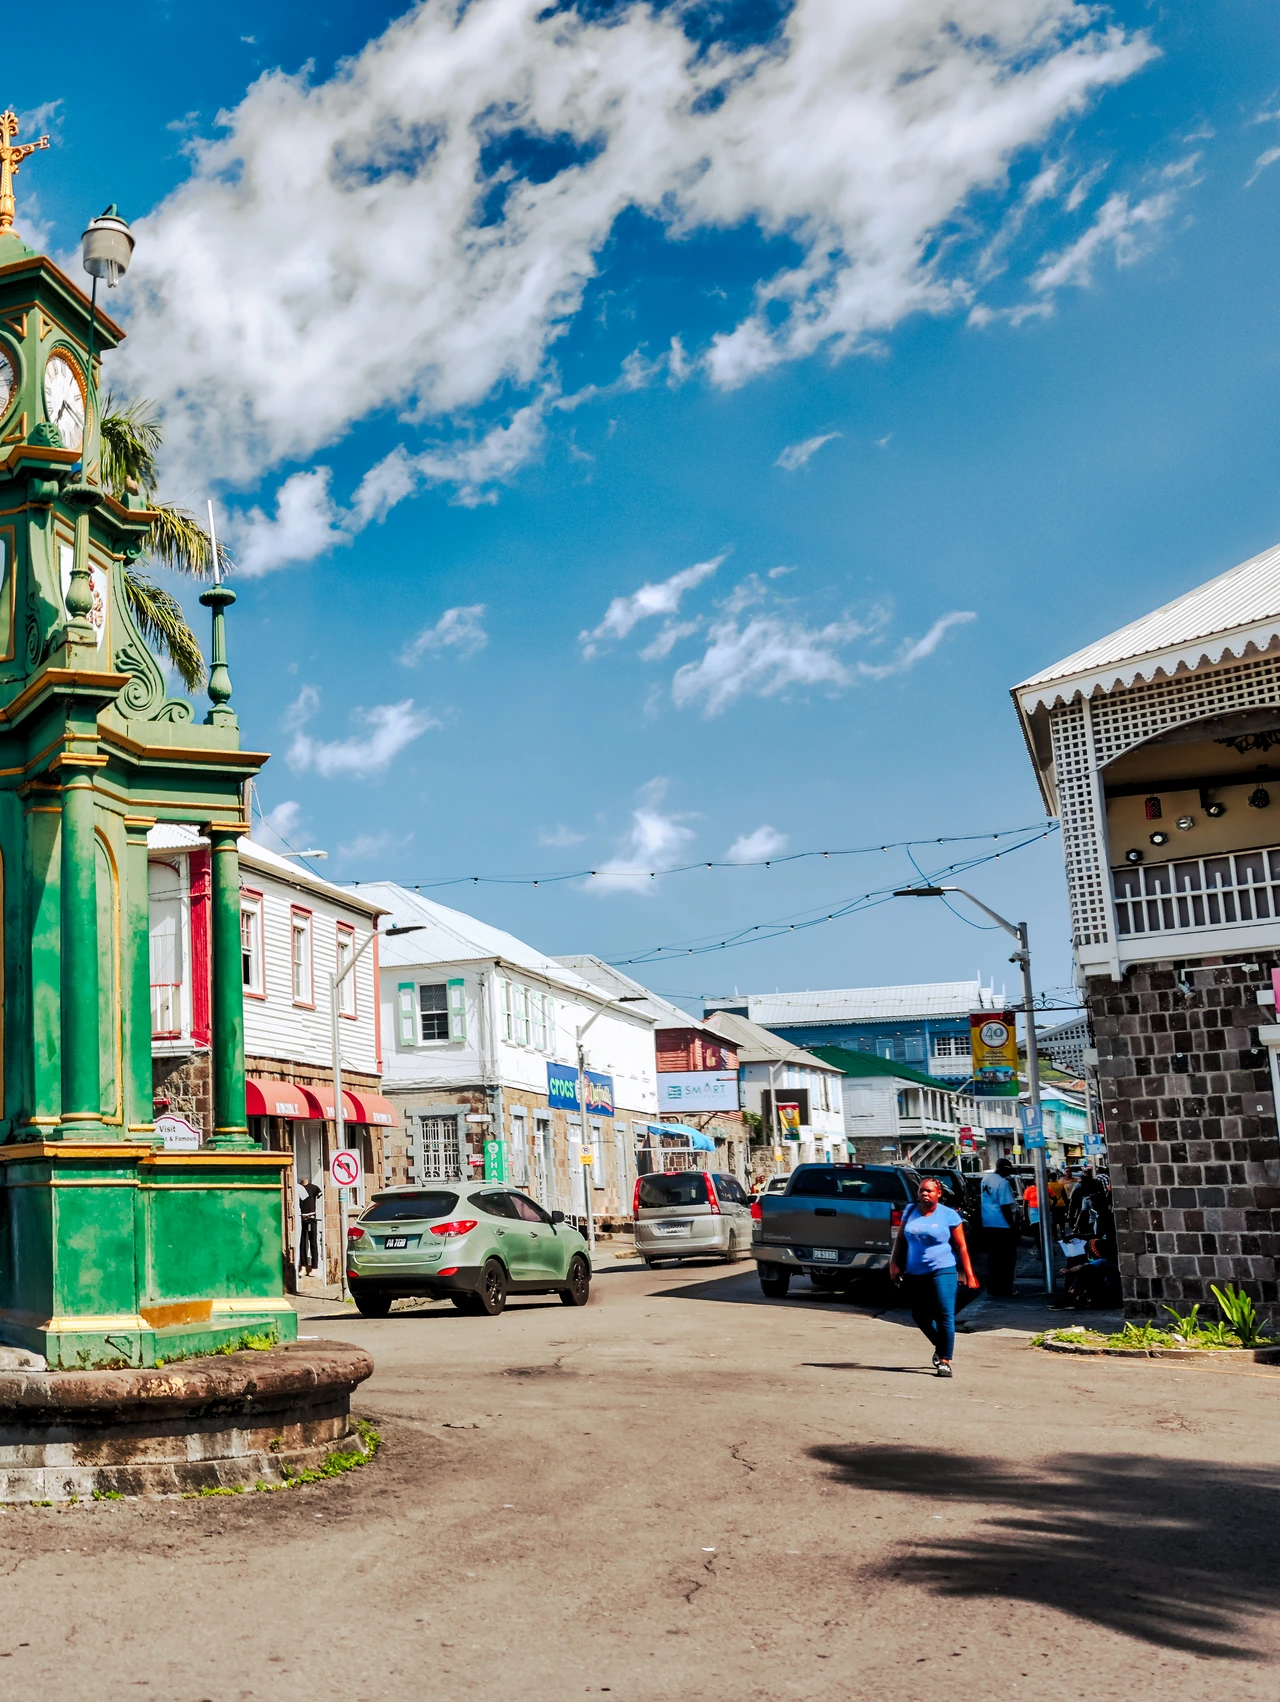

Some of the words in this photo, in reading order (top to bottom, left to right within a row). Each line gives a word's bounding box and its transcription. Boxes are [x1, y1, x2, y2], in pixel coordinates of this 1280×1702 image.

[549, 1077, 575, 1099] crocs
[684, 1082, 726, 1095] SMART
[1026, 1108, 1035, 1126] P
[159, 1125, 176, 1133] Visit
